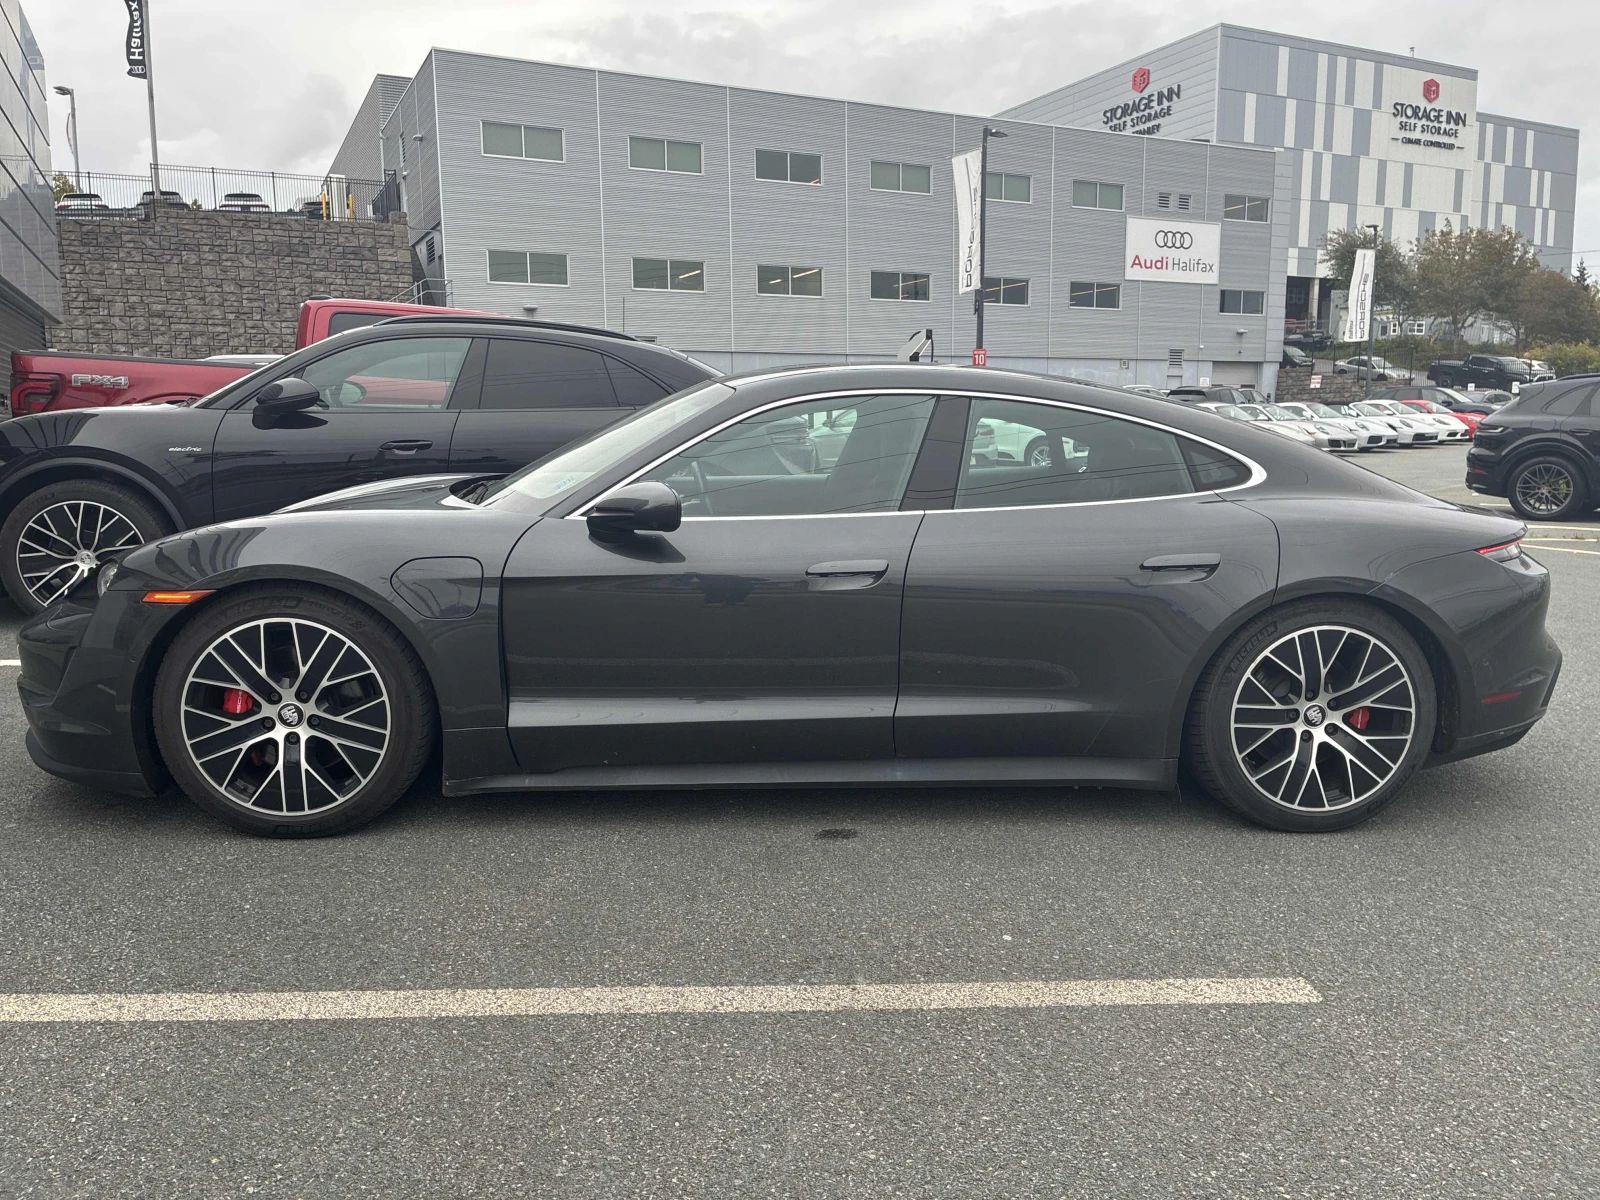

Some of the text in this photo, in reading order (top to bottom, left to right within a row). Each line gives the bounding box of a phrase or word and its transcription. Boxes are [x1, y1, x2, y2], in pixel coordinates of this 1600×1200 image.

[1102, 84, 1181, 125] STORAGE INN
[1109, 105, 1172, 132] SELF STORAGE
[1392, 101, 1467, 128] STORAGE INN
[1399, 121, 1459, 138] SELF STORAGE
[1130, 254, 1215, 273] Audi Halifax
[974, 354, 985, 365] 10
[71, 373, 129, 387] FX4
